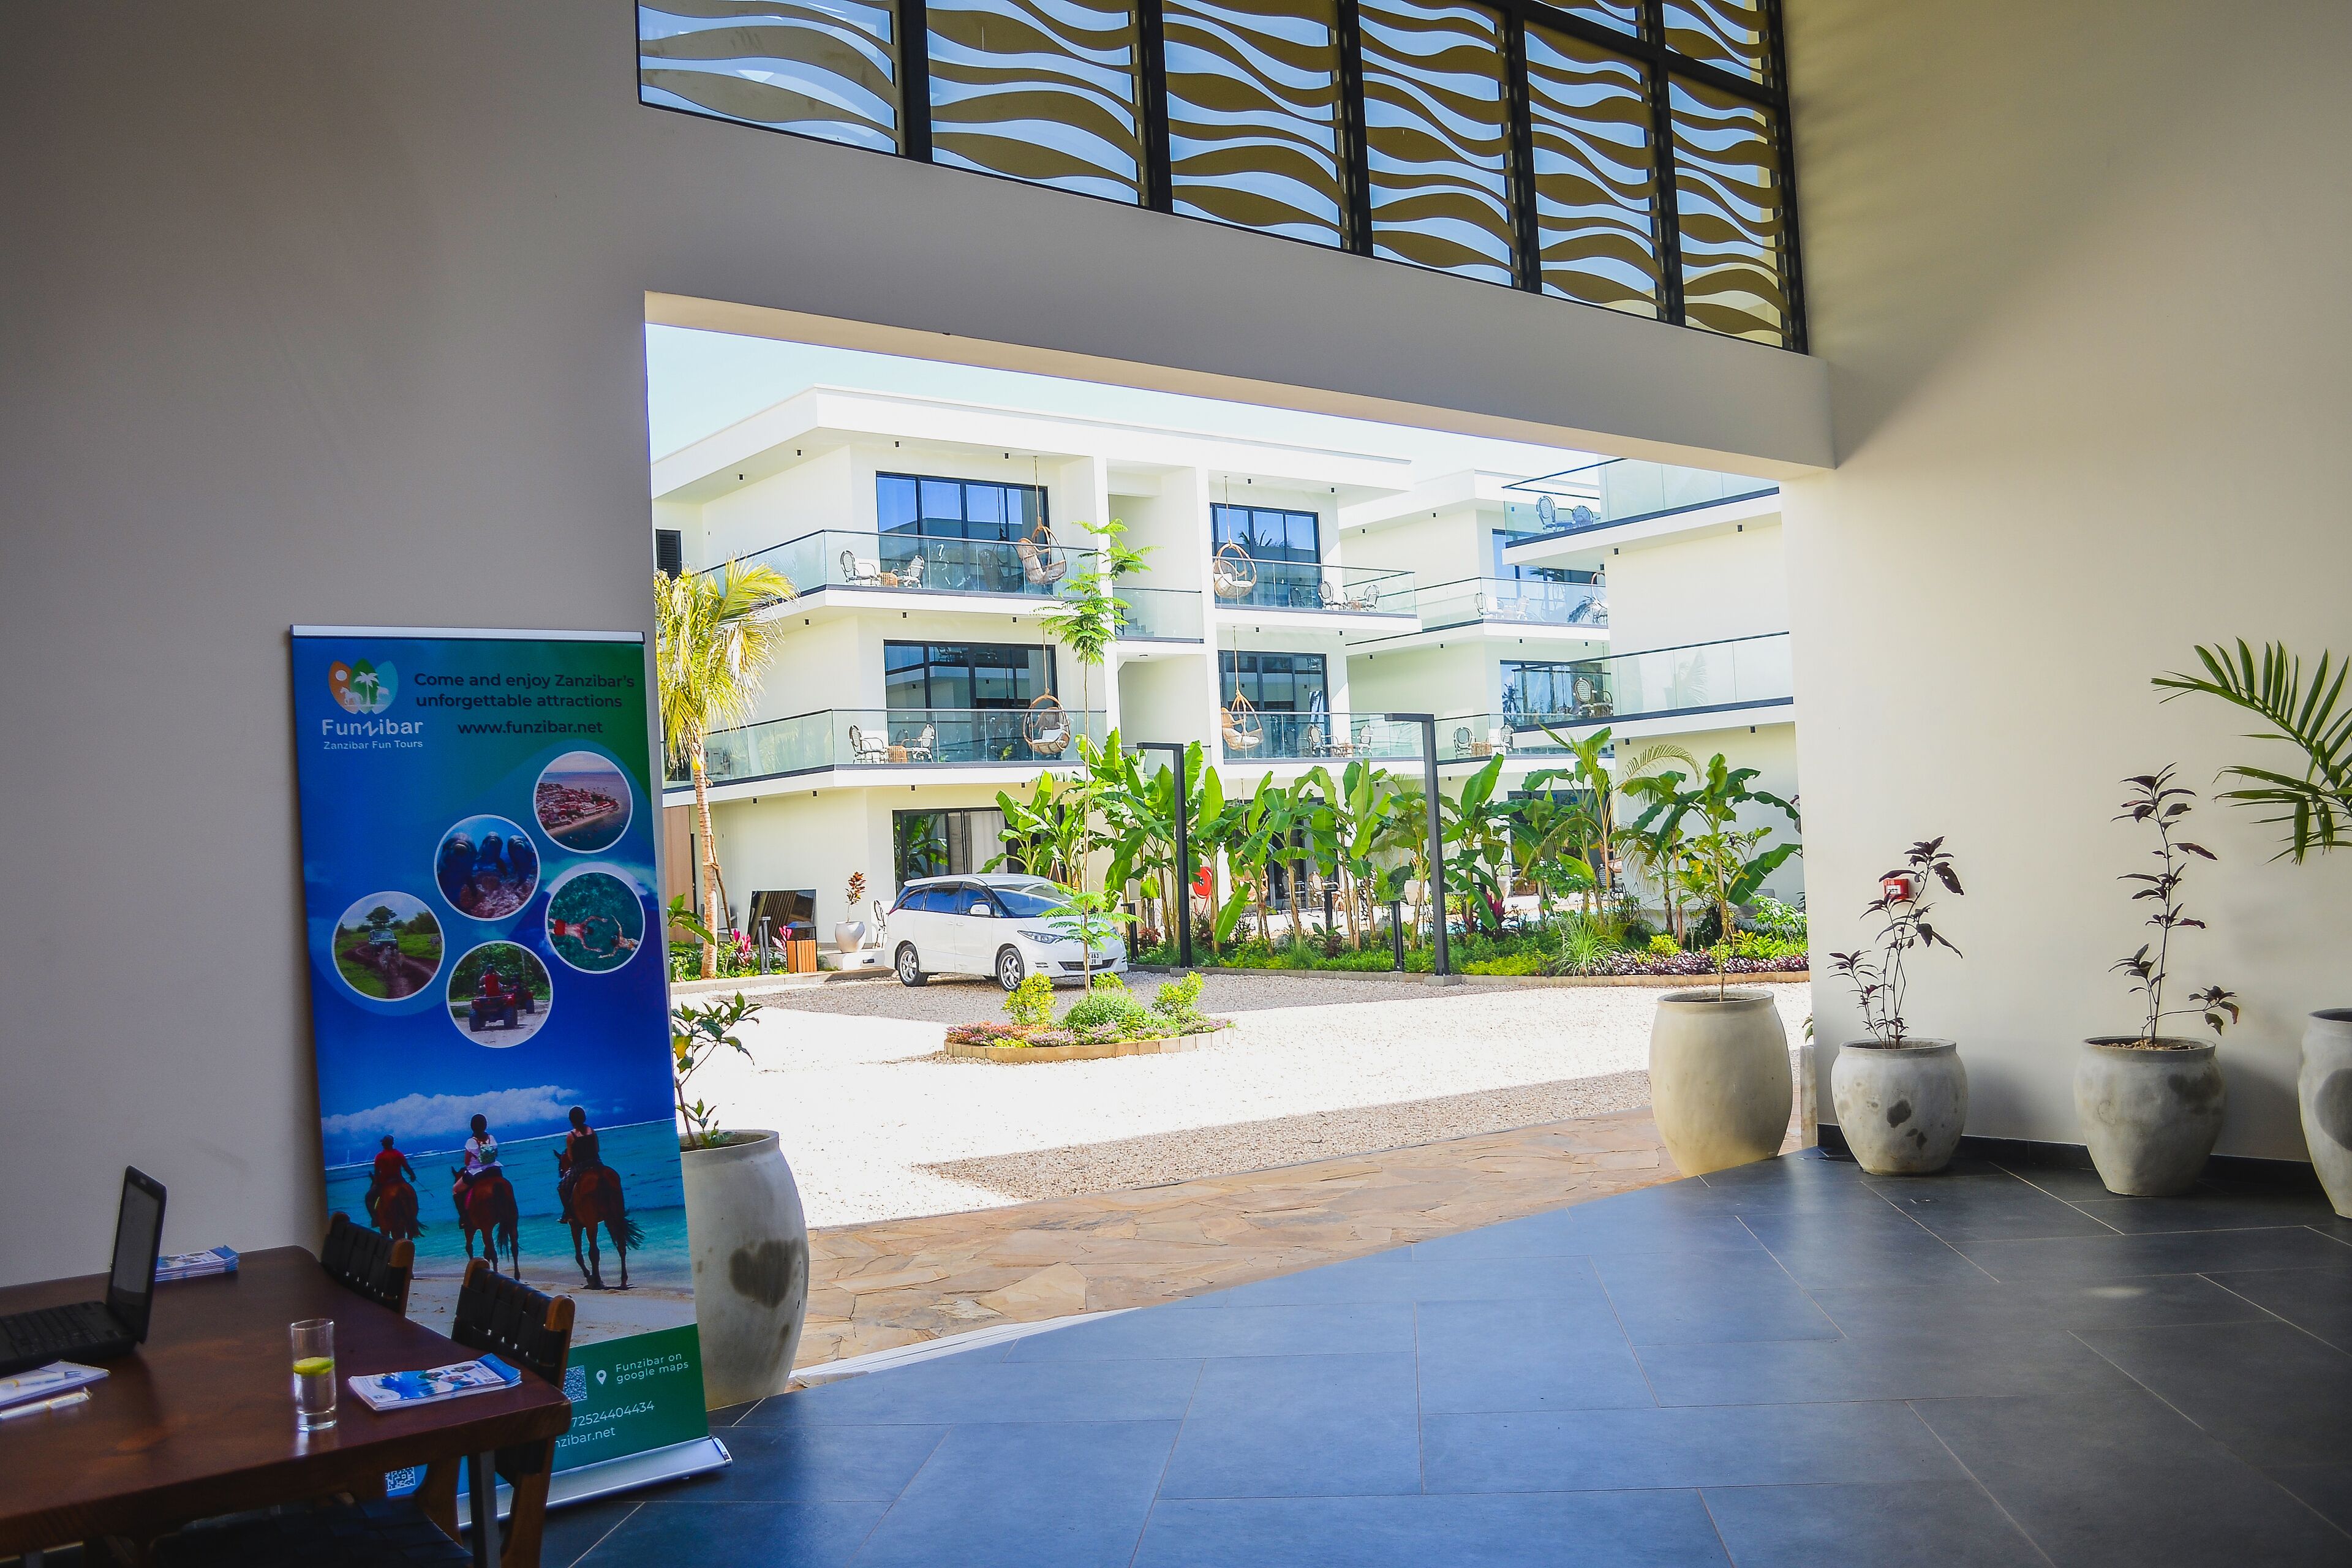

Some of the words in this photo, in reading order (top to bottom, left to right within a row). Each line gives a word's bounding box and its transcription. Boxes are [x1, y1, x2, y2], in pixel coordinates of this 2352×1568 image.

[414, 673, 464, 686] Come
[469, 673, 500, 686] and
[506, 673, 551, 689] enjoy
[554, 674, 635, 687] Zanzibar's
[416, 693, 532, 710] unforgettable
[537, 694, 622, 707] attractions
[322, 718, 423, 736] Funzibar
[458, 720, 603, 734] www.funzibar.net
[616, 1357, 665, 1372] Funzibar
[668, 1353, 682, 1362] on
[616, 1368, 655, 1384] google
[659, 1362, 688, 1373] maps
[571, 1400, 655, 1427] 72524404434
[555, 1427, 616, 1448] nzibar.net
